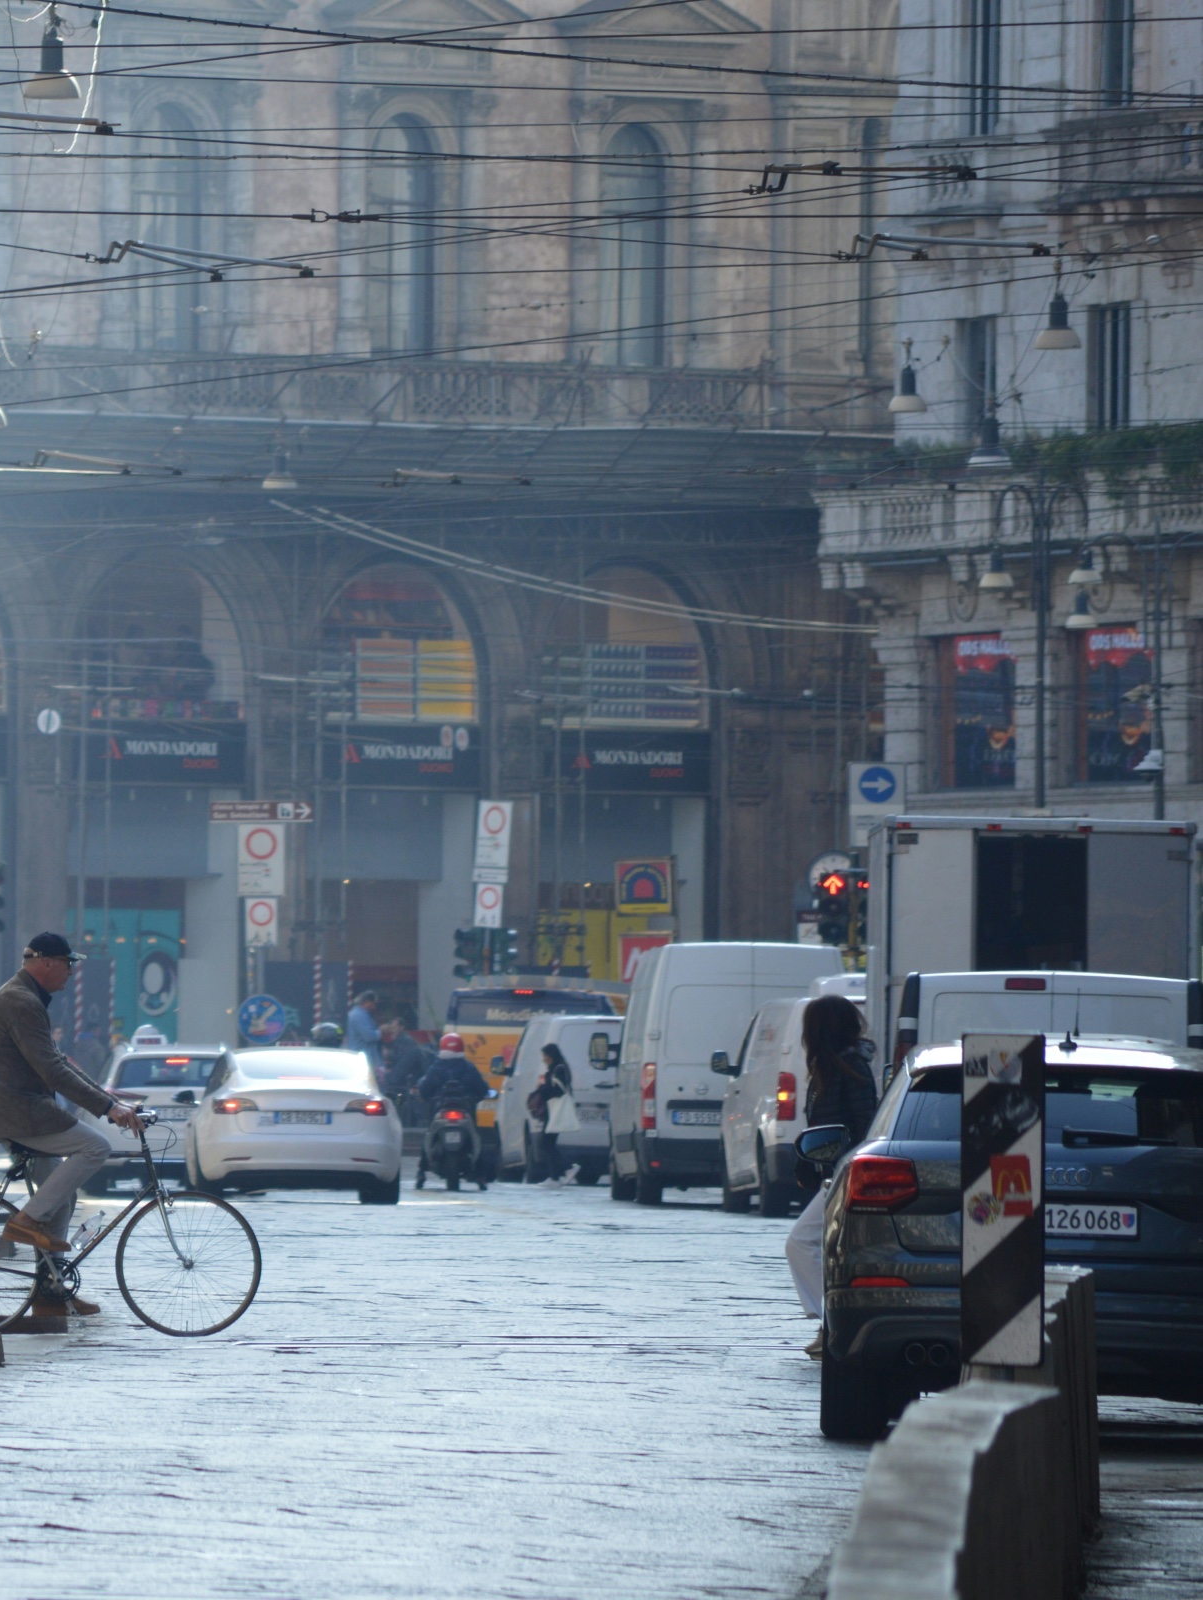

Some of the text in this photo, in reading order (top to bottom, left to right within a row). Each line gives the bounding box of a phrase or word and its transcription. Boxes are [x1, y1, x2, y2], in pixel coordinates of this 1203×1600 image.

[124, 740, 218, 756] MONDADORI
[361, 745, 453, 760] MONDADORI
[593, 750, 683, 765] MONDADORI
